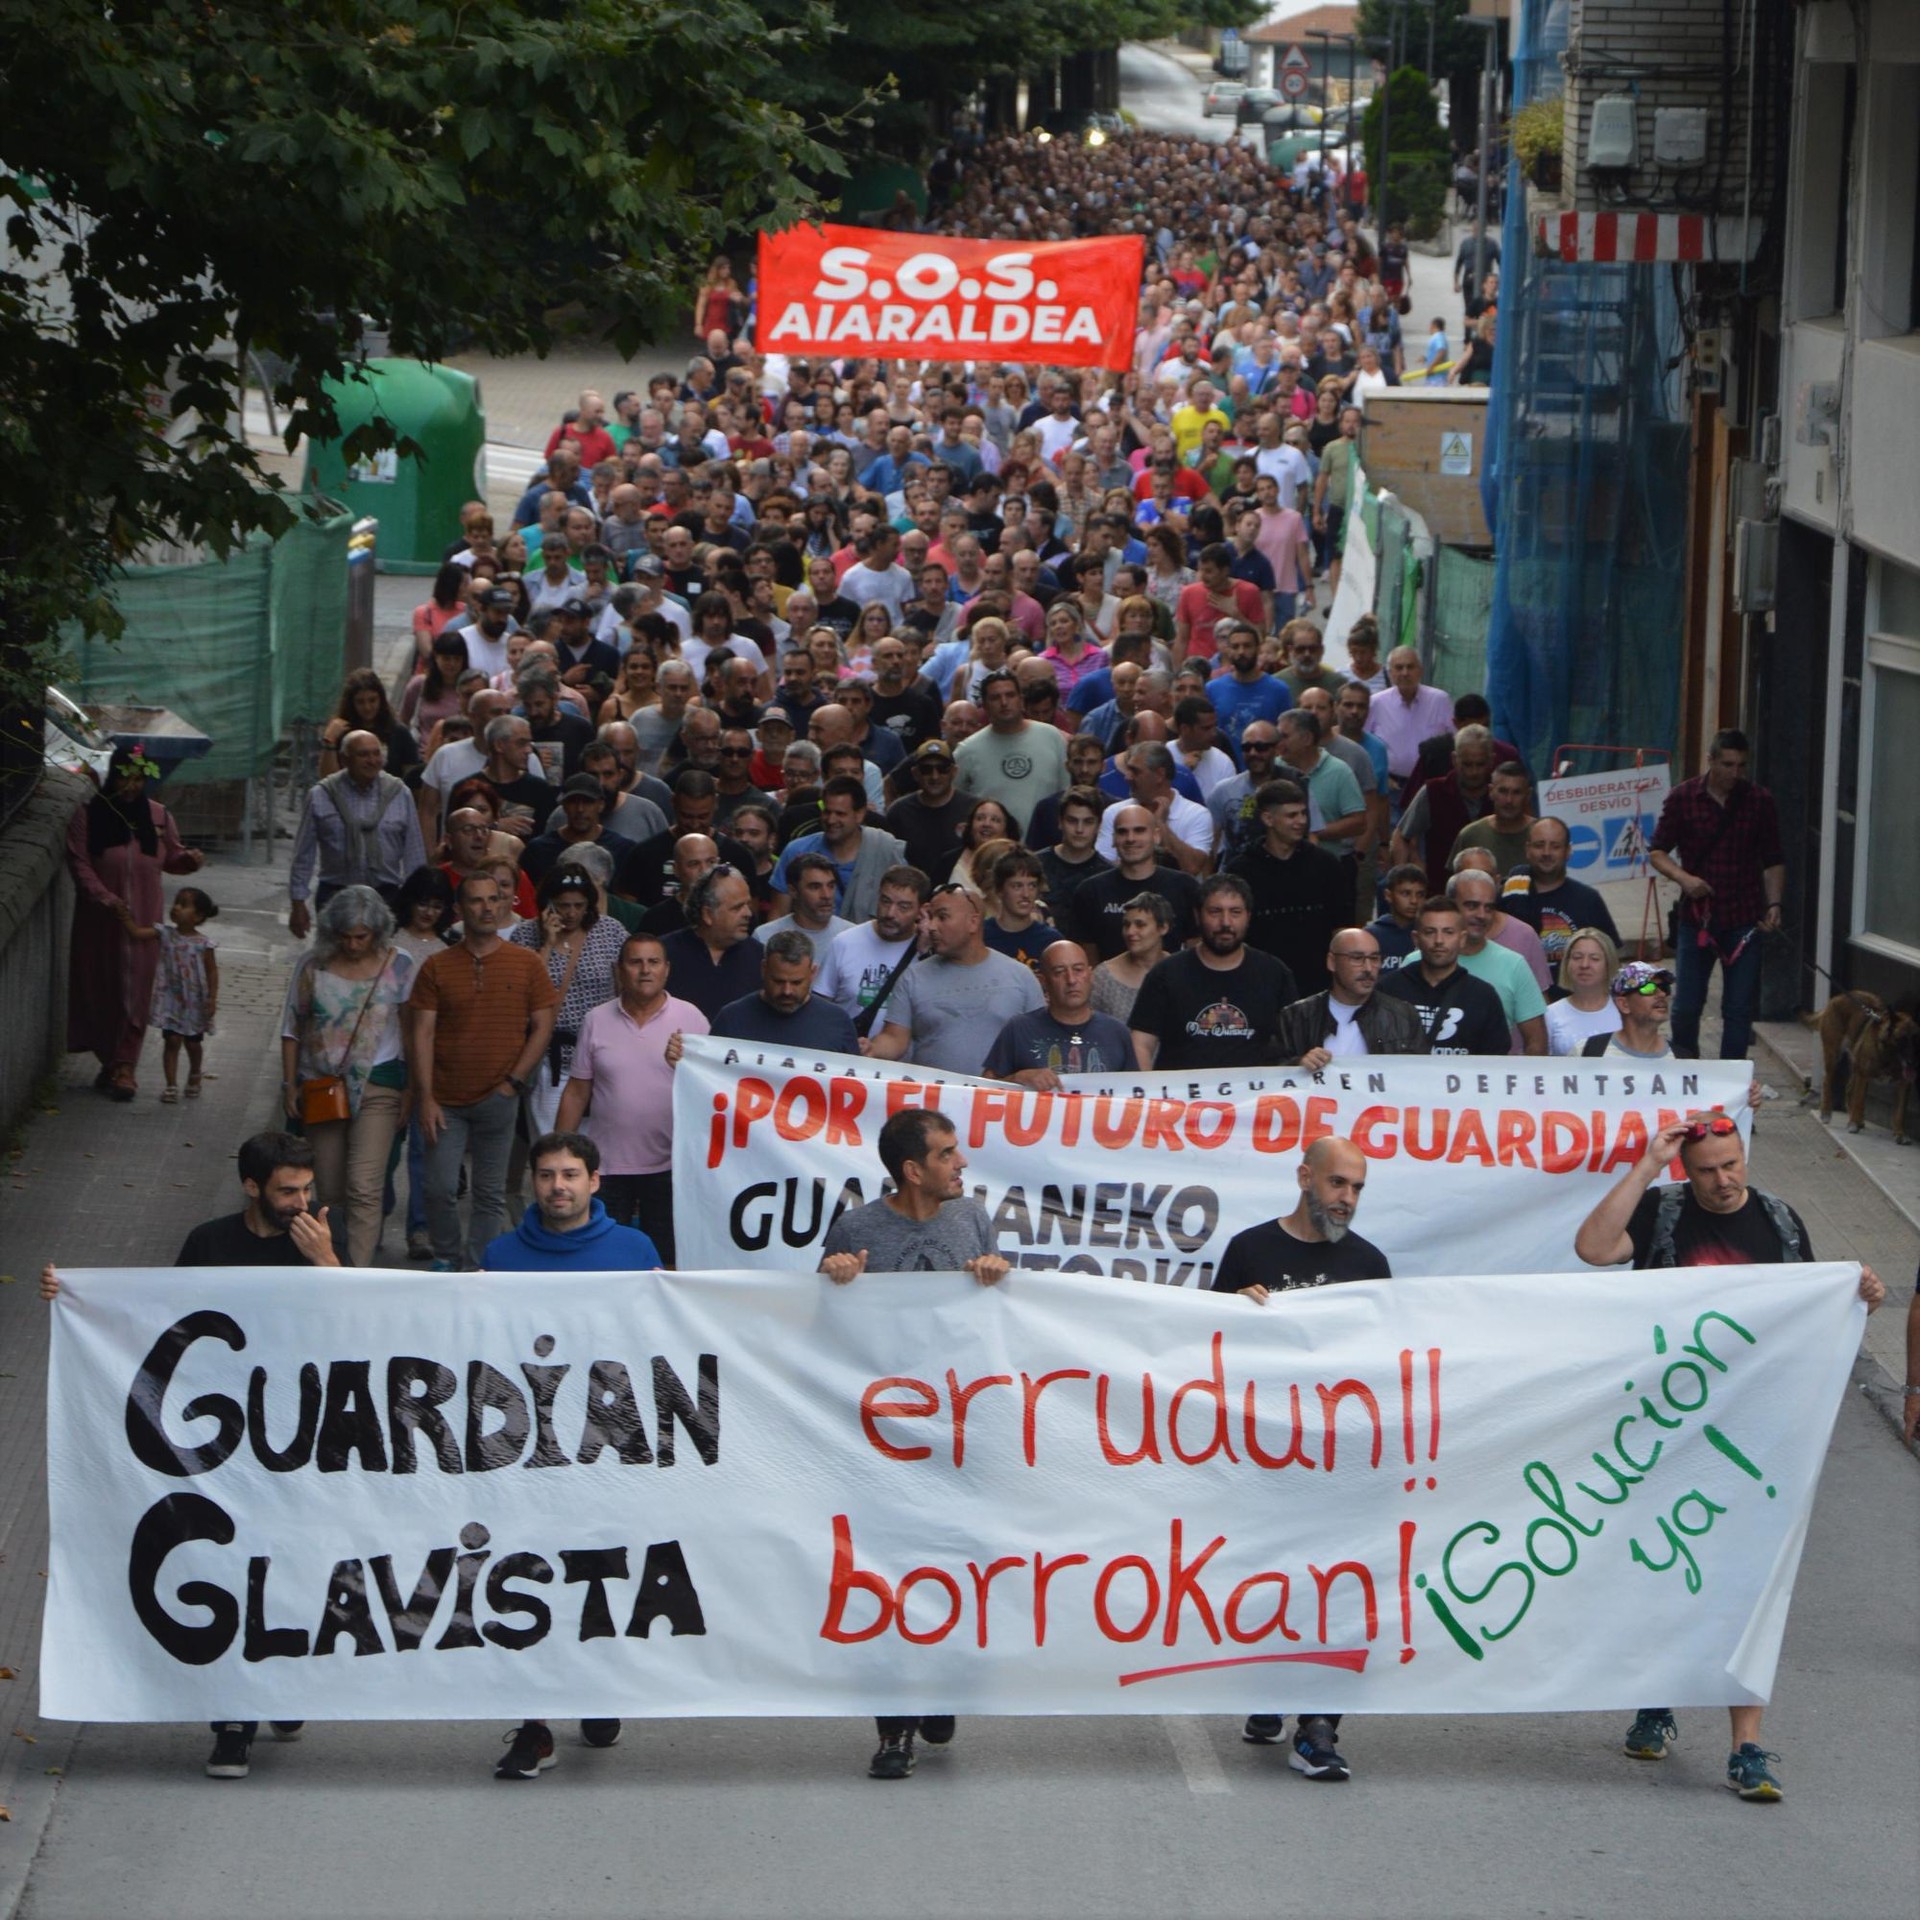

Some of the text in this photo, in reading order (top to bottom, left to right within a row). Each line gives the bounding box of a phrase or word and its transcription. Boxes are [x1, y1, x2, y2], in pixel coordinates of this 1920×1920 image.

[813, 246, 1059, 300] S.O.S.
[768, 303, 1103, 345] AIARALDEA
[1446, 1074, 1699, 1096] DEFENTSAN
[707, 1076, 868, 1169] ¡POR
[968, 1087, 1237, 1152] FUTURO
[1252, 1094, 1339, 1155] DE
[860, 1331, 1442, 1492] errudun!!
[1629, 1423, 1778, 1595] ya!
